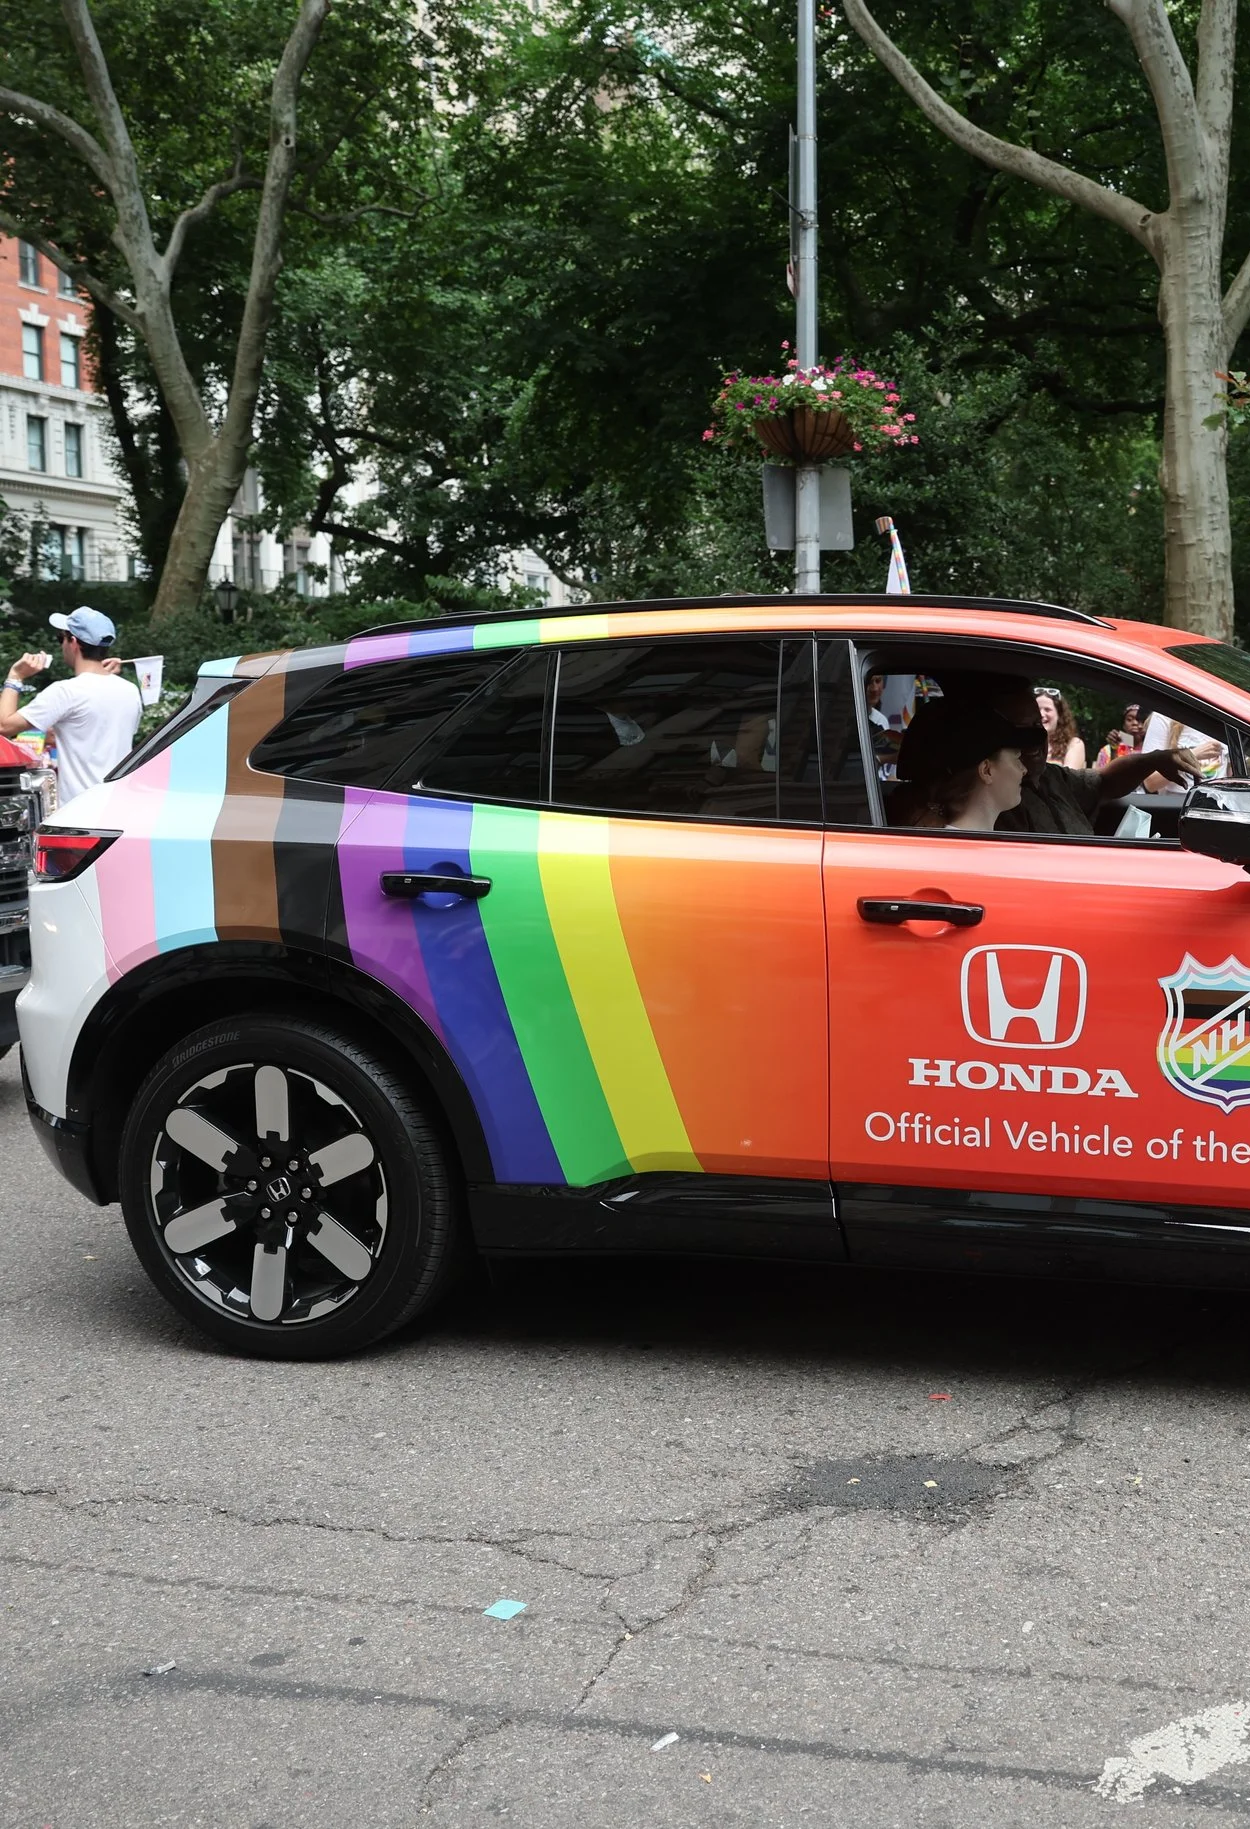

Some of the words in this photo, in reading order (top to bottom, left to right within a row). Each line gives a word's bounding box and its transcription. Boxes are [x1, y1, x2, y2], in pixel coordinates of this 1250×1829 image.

[908, 1058, 1139, 1098] HONDA
[865, 1112, 990, 1148] Official
[1003, 1120, 1133, 1157] Vehicle
[1146, 1128, 1184, 1160] of
